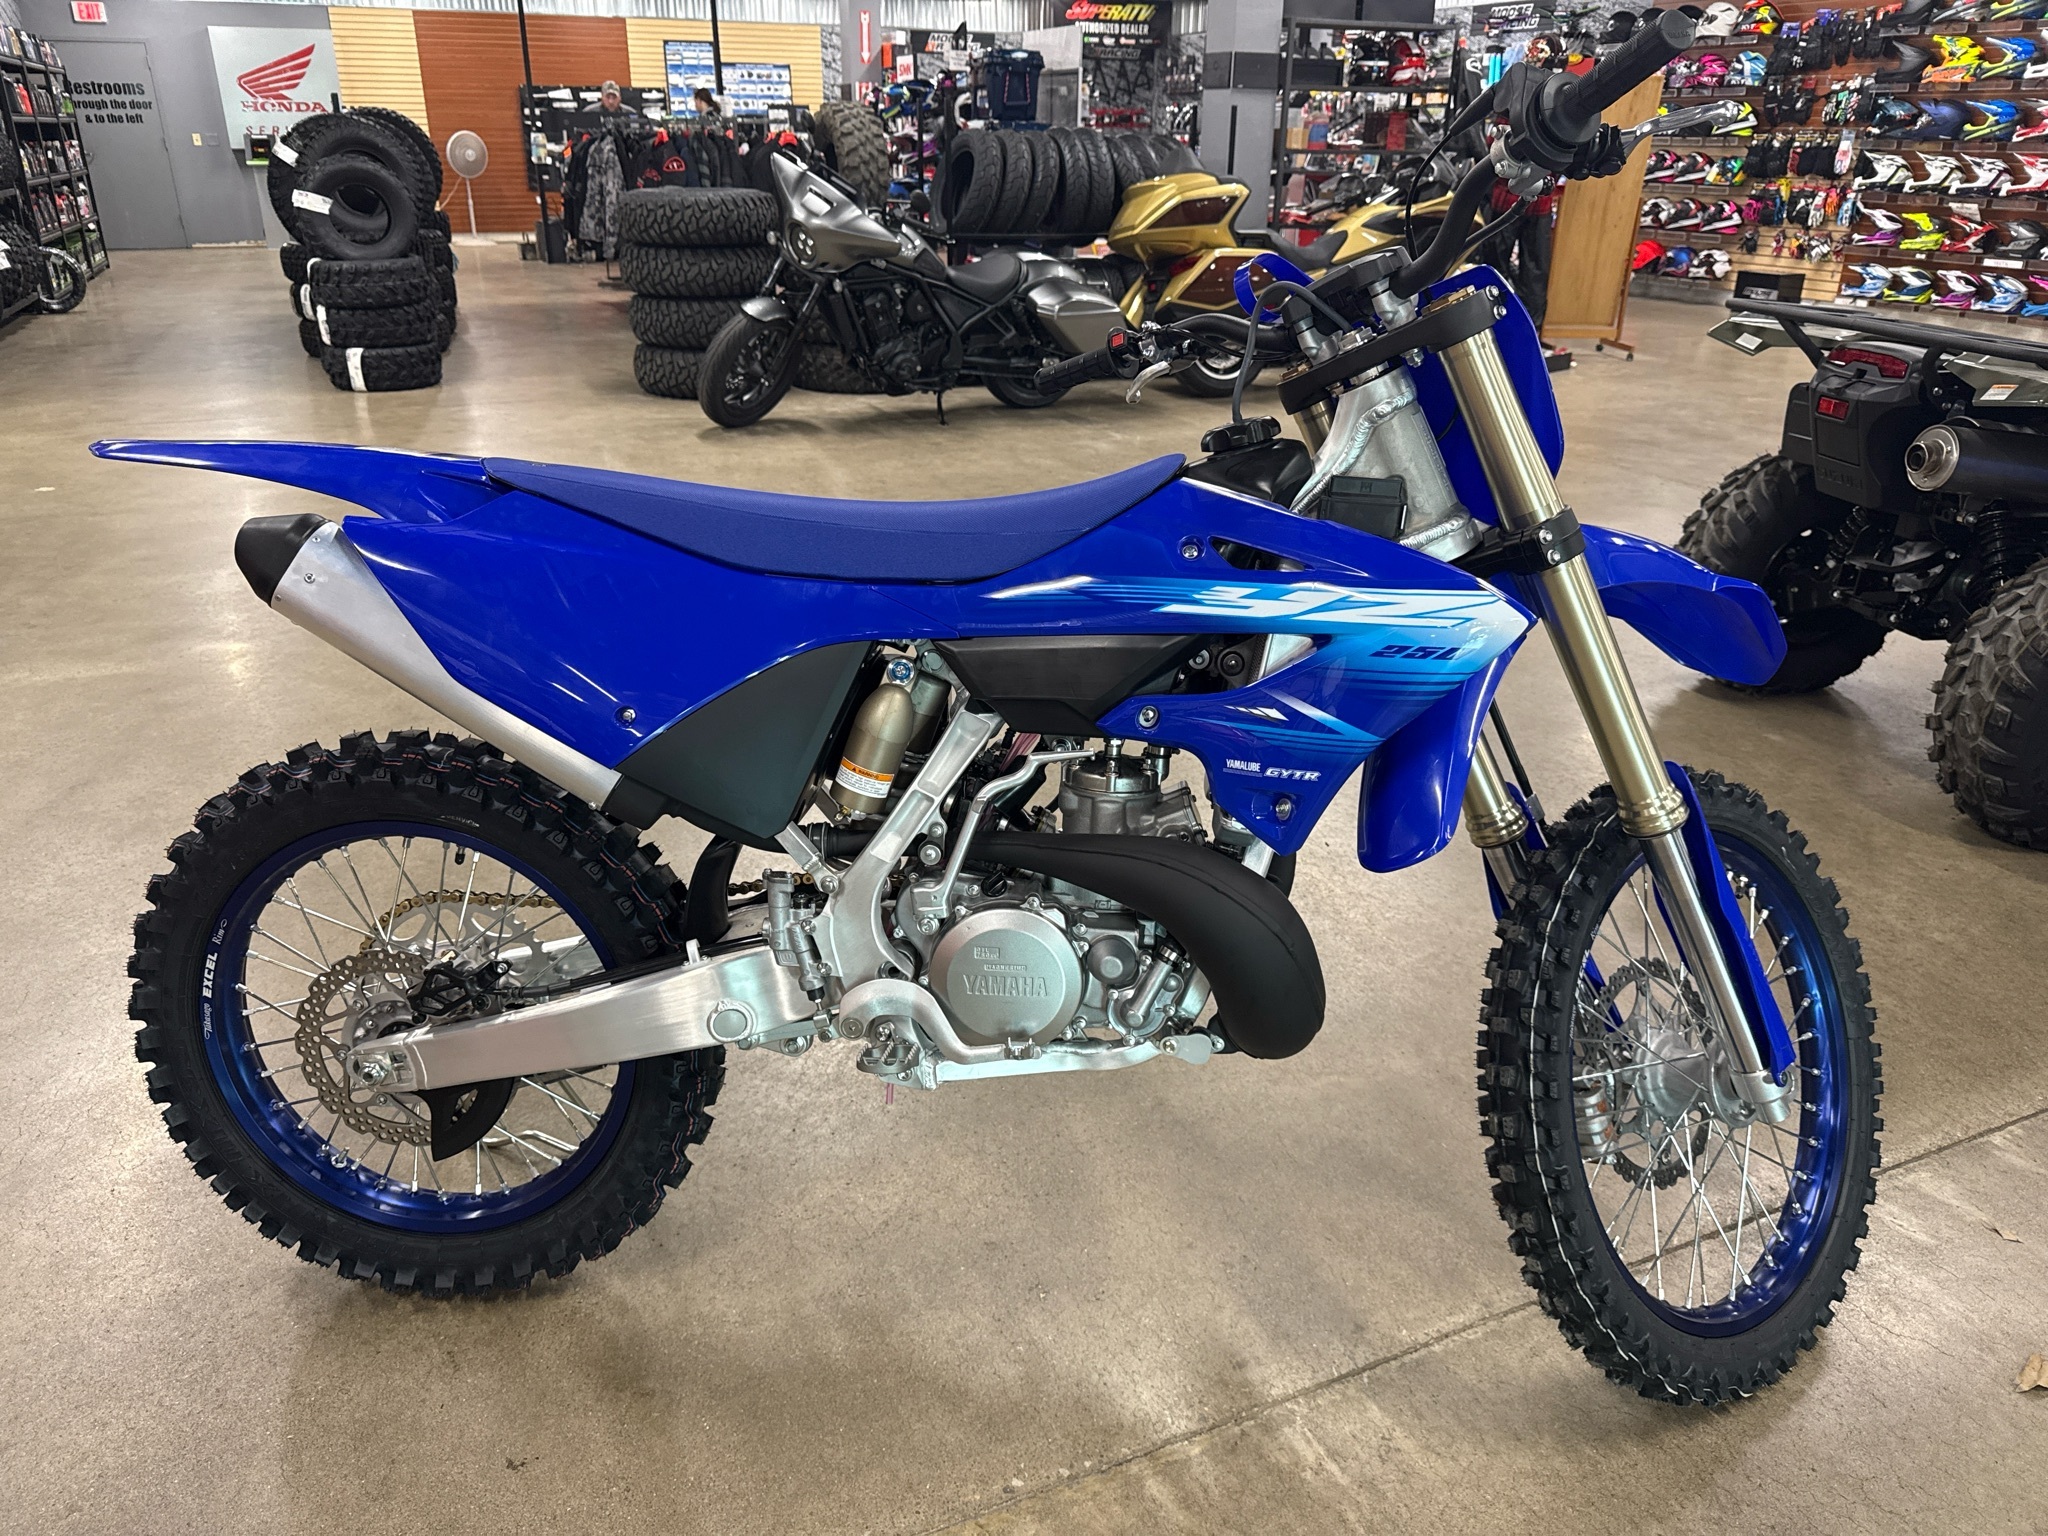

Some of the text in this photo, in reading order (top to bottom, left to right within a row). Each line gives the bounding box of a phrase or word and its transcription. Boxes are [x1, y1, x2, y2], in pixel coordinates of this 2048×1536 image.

[77, 2, 101, 20] EXIT
[1490, 5, 1532, 18] MOOSE
[1121, 23, 1149, 35] DEALER
[899, 64, 911, 75] SMK
[73, 99, 152, 110] hrough the door
[241, 101, 329, 113] HONDA
[85, 113, 144, 124] & to the left
[1226, 759, 1261, 772] YAMALUBE
[1264, 767, 1322, 781] GYTR
[202, 952, 218, 998] EXCEL
[963, 974, 1048, 997] YAMAHA
